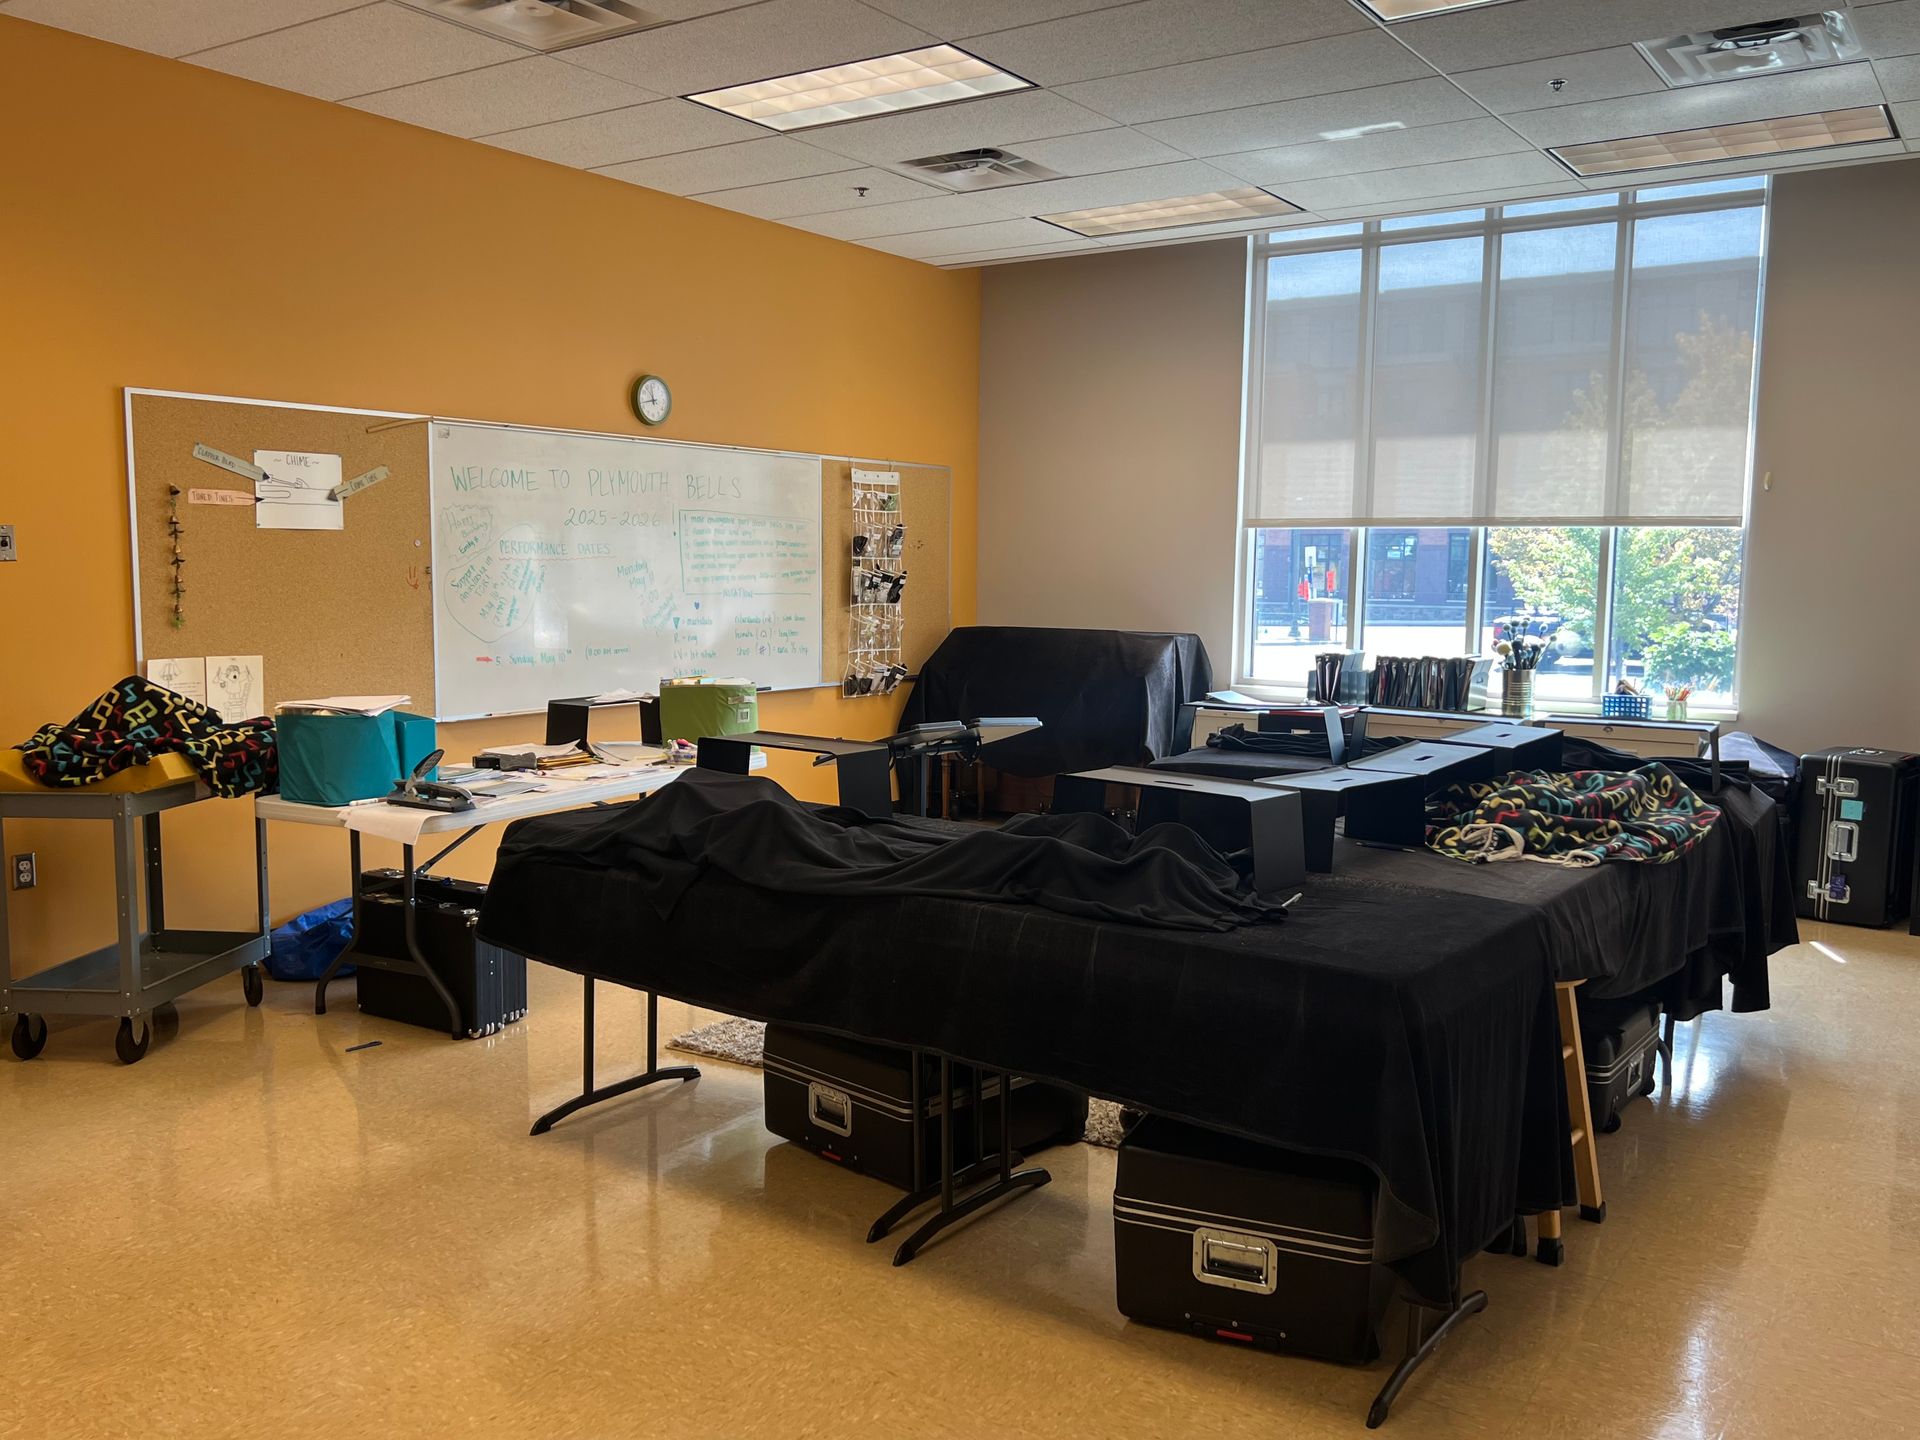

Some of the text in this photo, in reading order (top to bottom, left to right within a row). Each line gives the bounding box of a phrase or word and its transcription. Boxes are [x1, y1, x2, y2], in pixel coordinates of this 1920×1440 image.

[285, 453, 310, 468] CHIME
[450, 466, 742, 500] WELCOME TO PLYMOUTH BELLS
[500, 539, 610, 556] PERFORMANCE DATES
[616, 560, 649, 577] Monday
